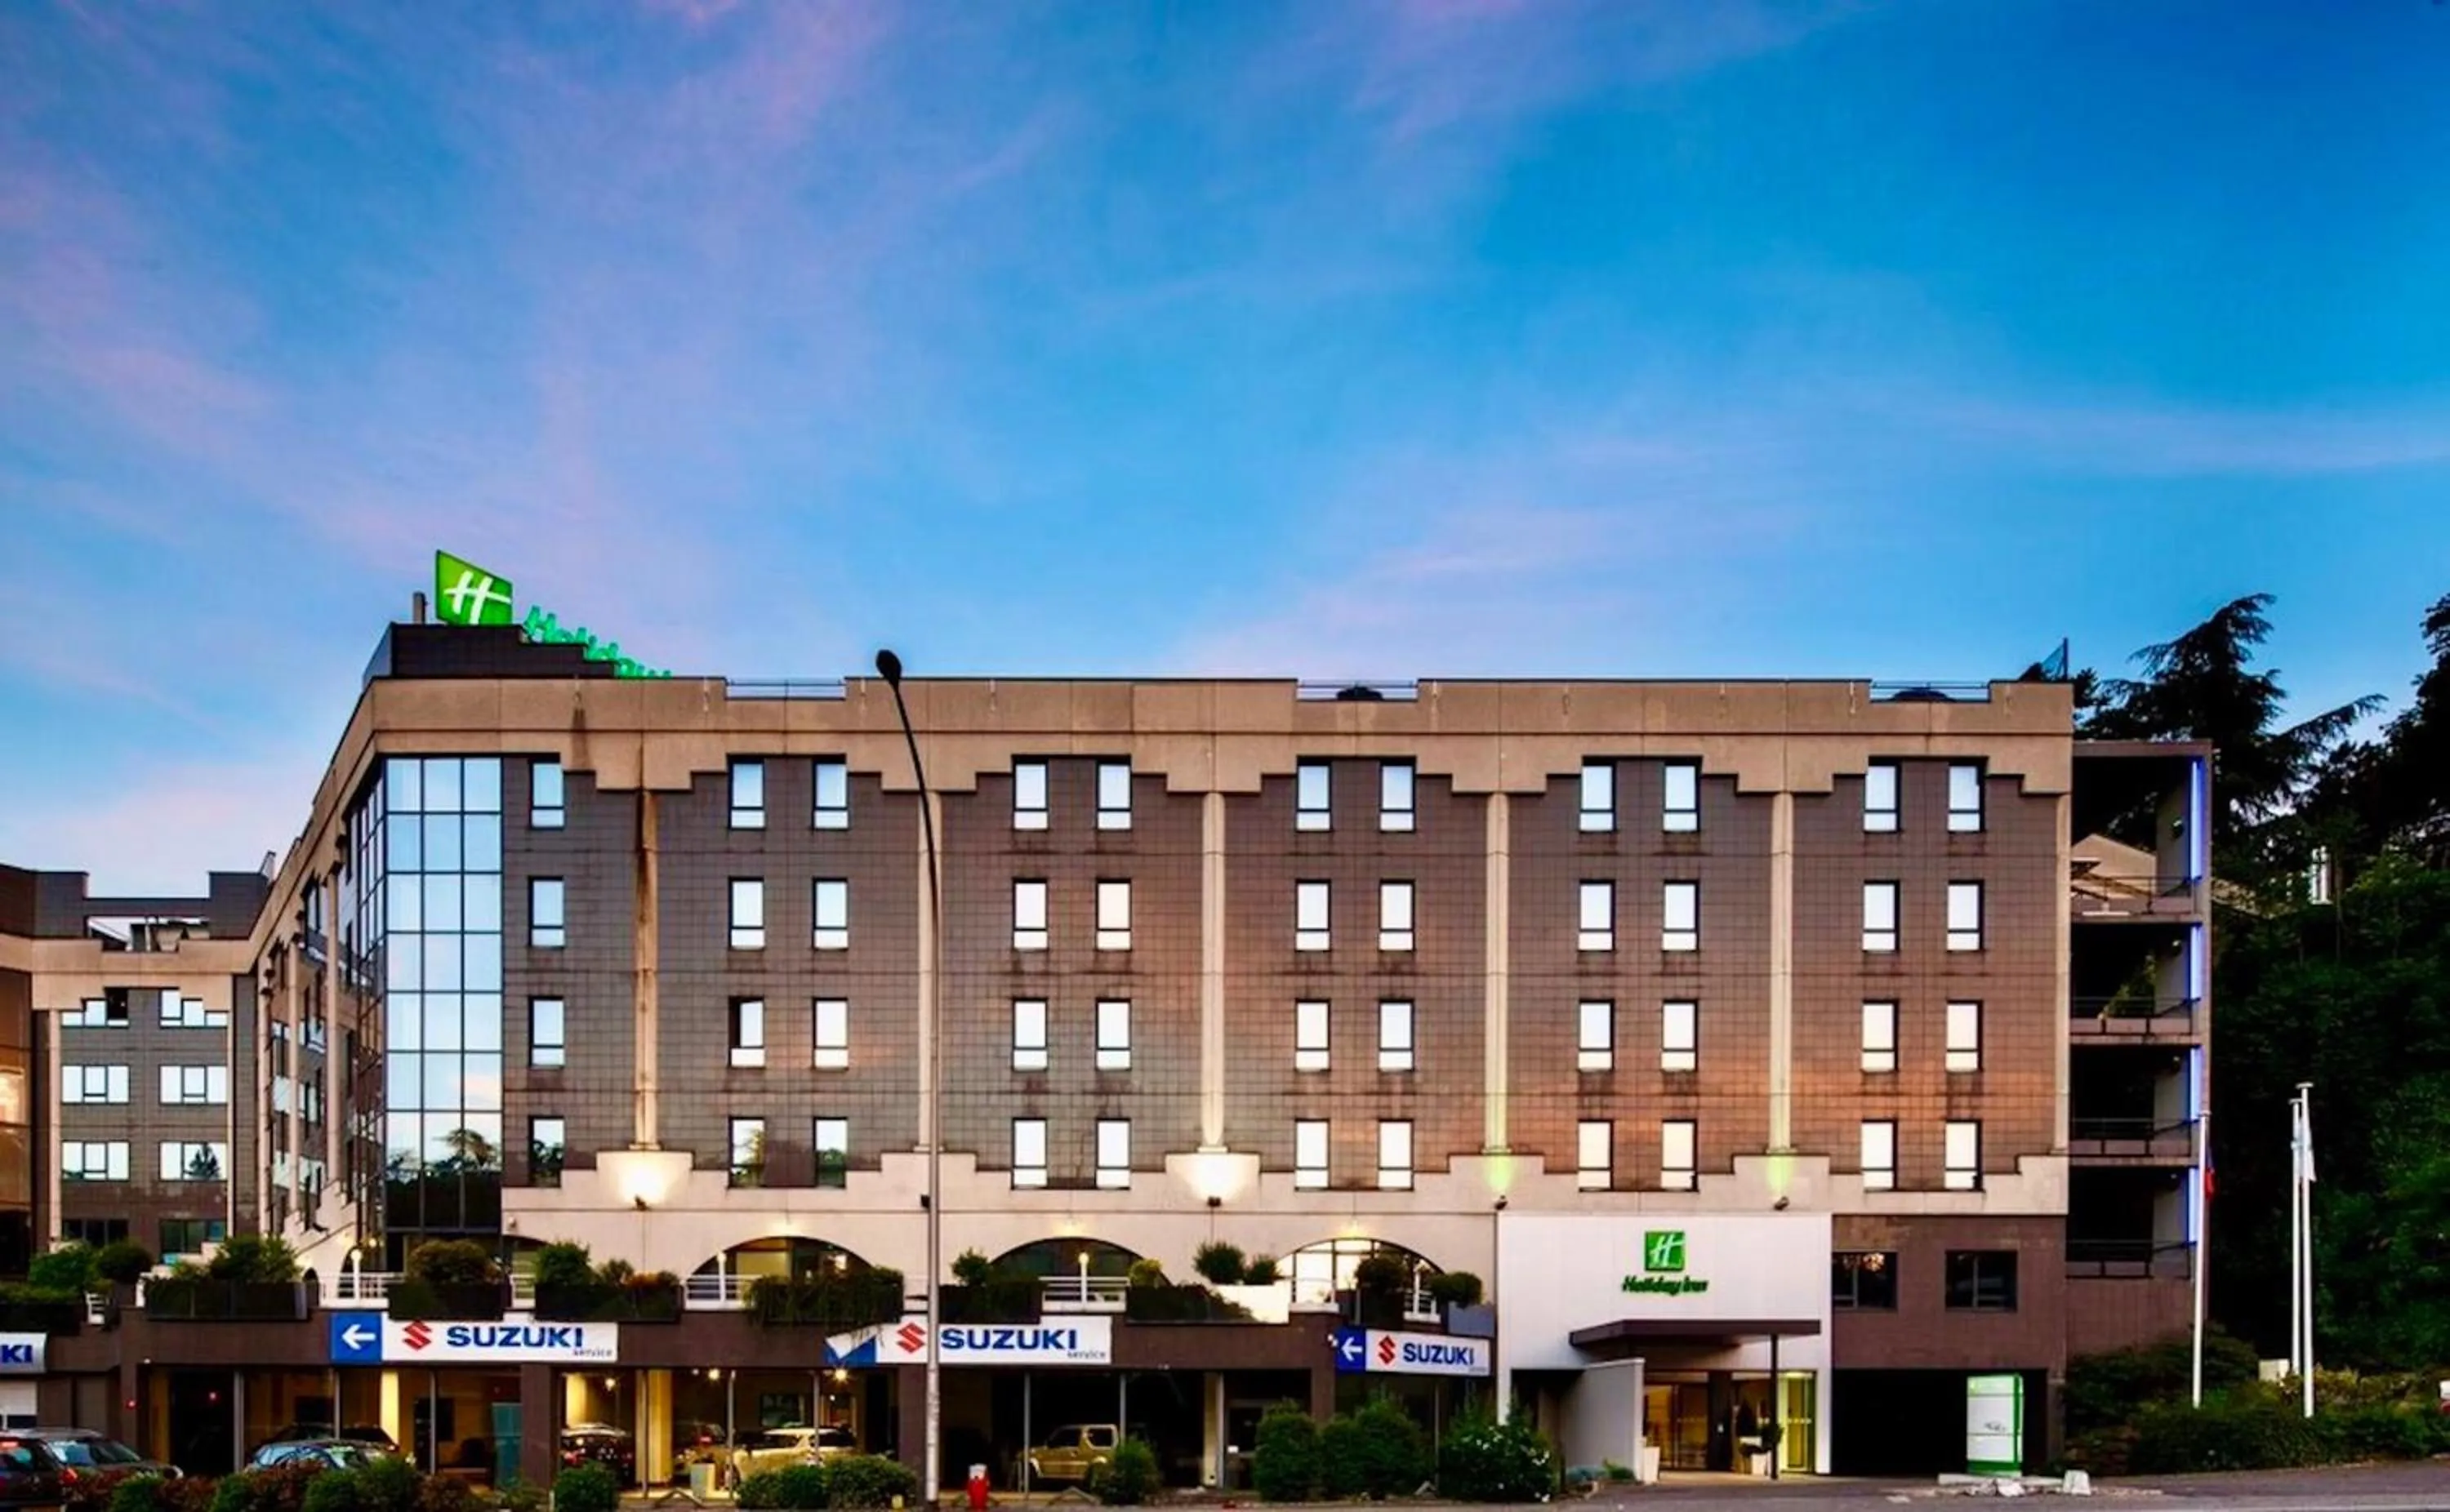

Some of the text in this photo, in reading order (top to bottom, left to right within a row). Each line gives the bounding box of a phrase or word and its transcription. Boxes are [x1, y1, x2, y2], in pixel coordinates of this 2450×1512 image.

[1622, 1275, 1681, 1296] Holiday
[446, 1326, 584, 1348] SUZUKI
[940, 1327, 1076, 1350] SUZUKI
[1403, 1343, 1474, 1366] SUZUKI
